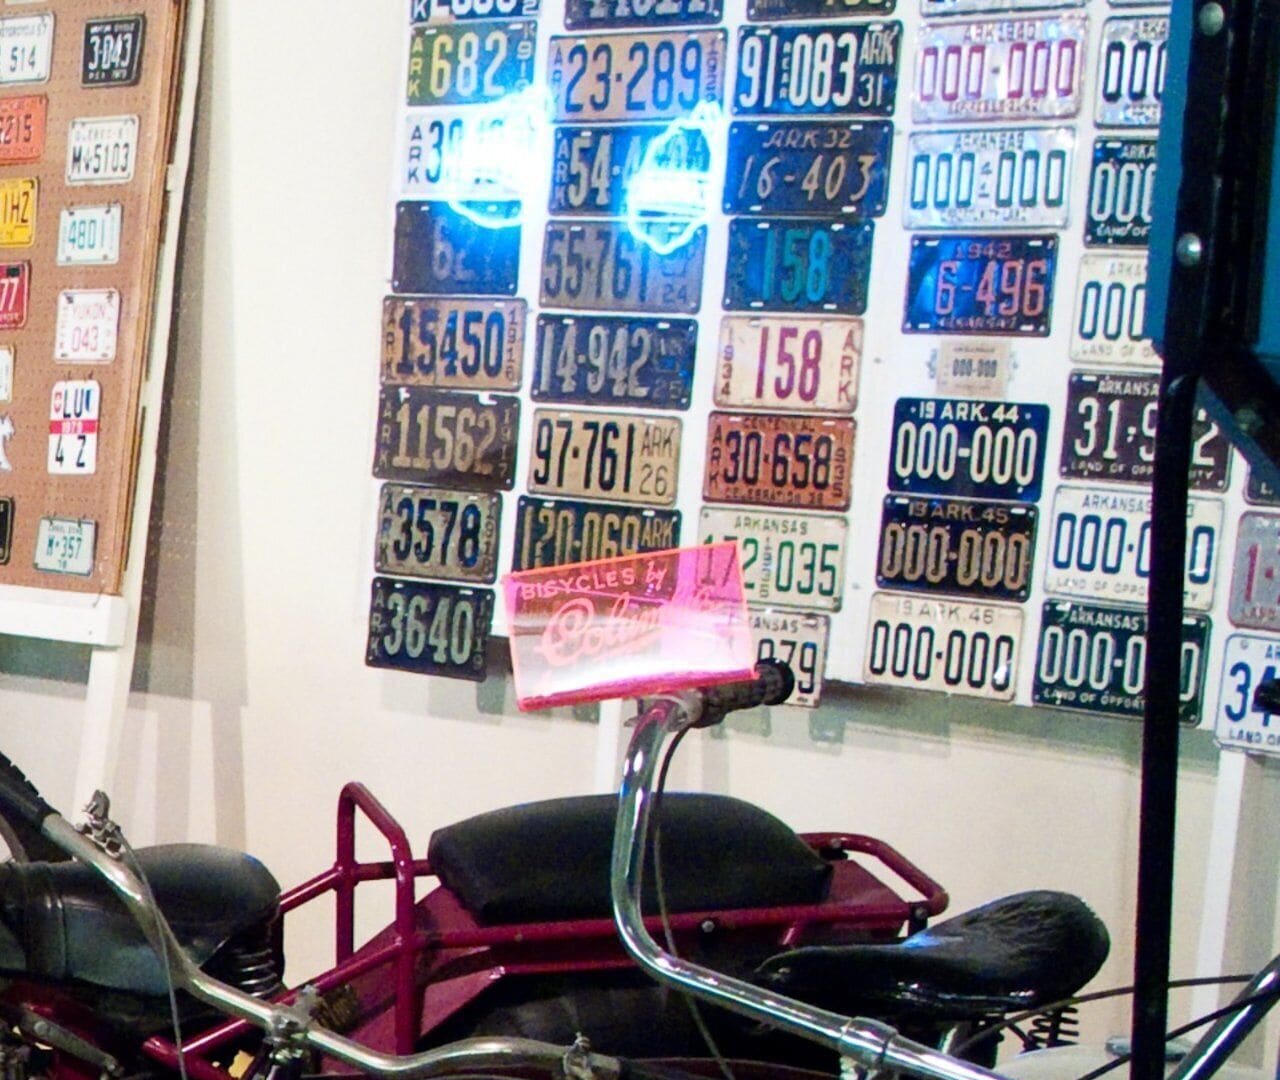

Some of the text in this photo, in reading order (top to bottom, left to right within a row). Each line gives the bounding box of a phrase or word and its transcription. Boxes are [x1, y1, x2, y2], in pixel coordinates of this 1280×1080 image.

[430, 31, 508, 98] 682
[788, 32, 857, 107] 083
[858, 29, 895, 65] ARK
[857, 73, 882, 106] 31
[762, 129, 852, 149] ARK 32
[396, 308, 505, 377] 15450
[756, 326, 822, 402] 158
[392, 402, 496, 475] 11562
[992, 404, 1020, 423] 44
[639, 463, 669, 496] 26
[393, 497, 481, 568] 3578
[734, 516, 809, 535] ARKANSAS
[776, 540, 839, 597] 035
[383, 592, 474, 665] 3640
